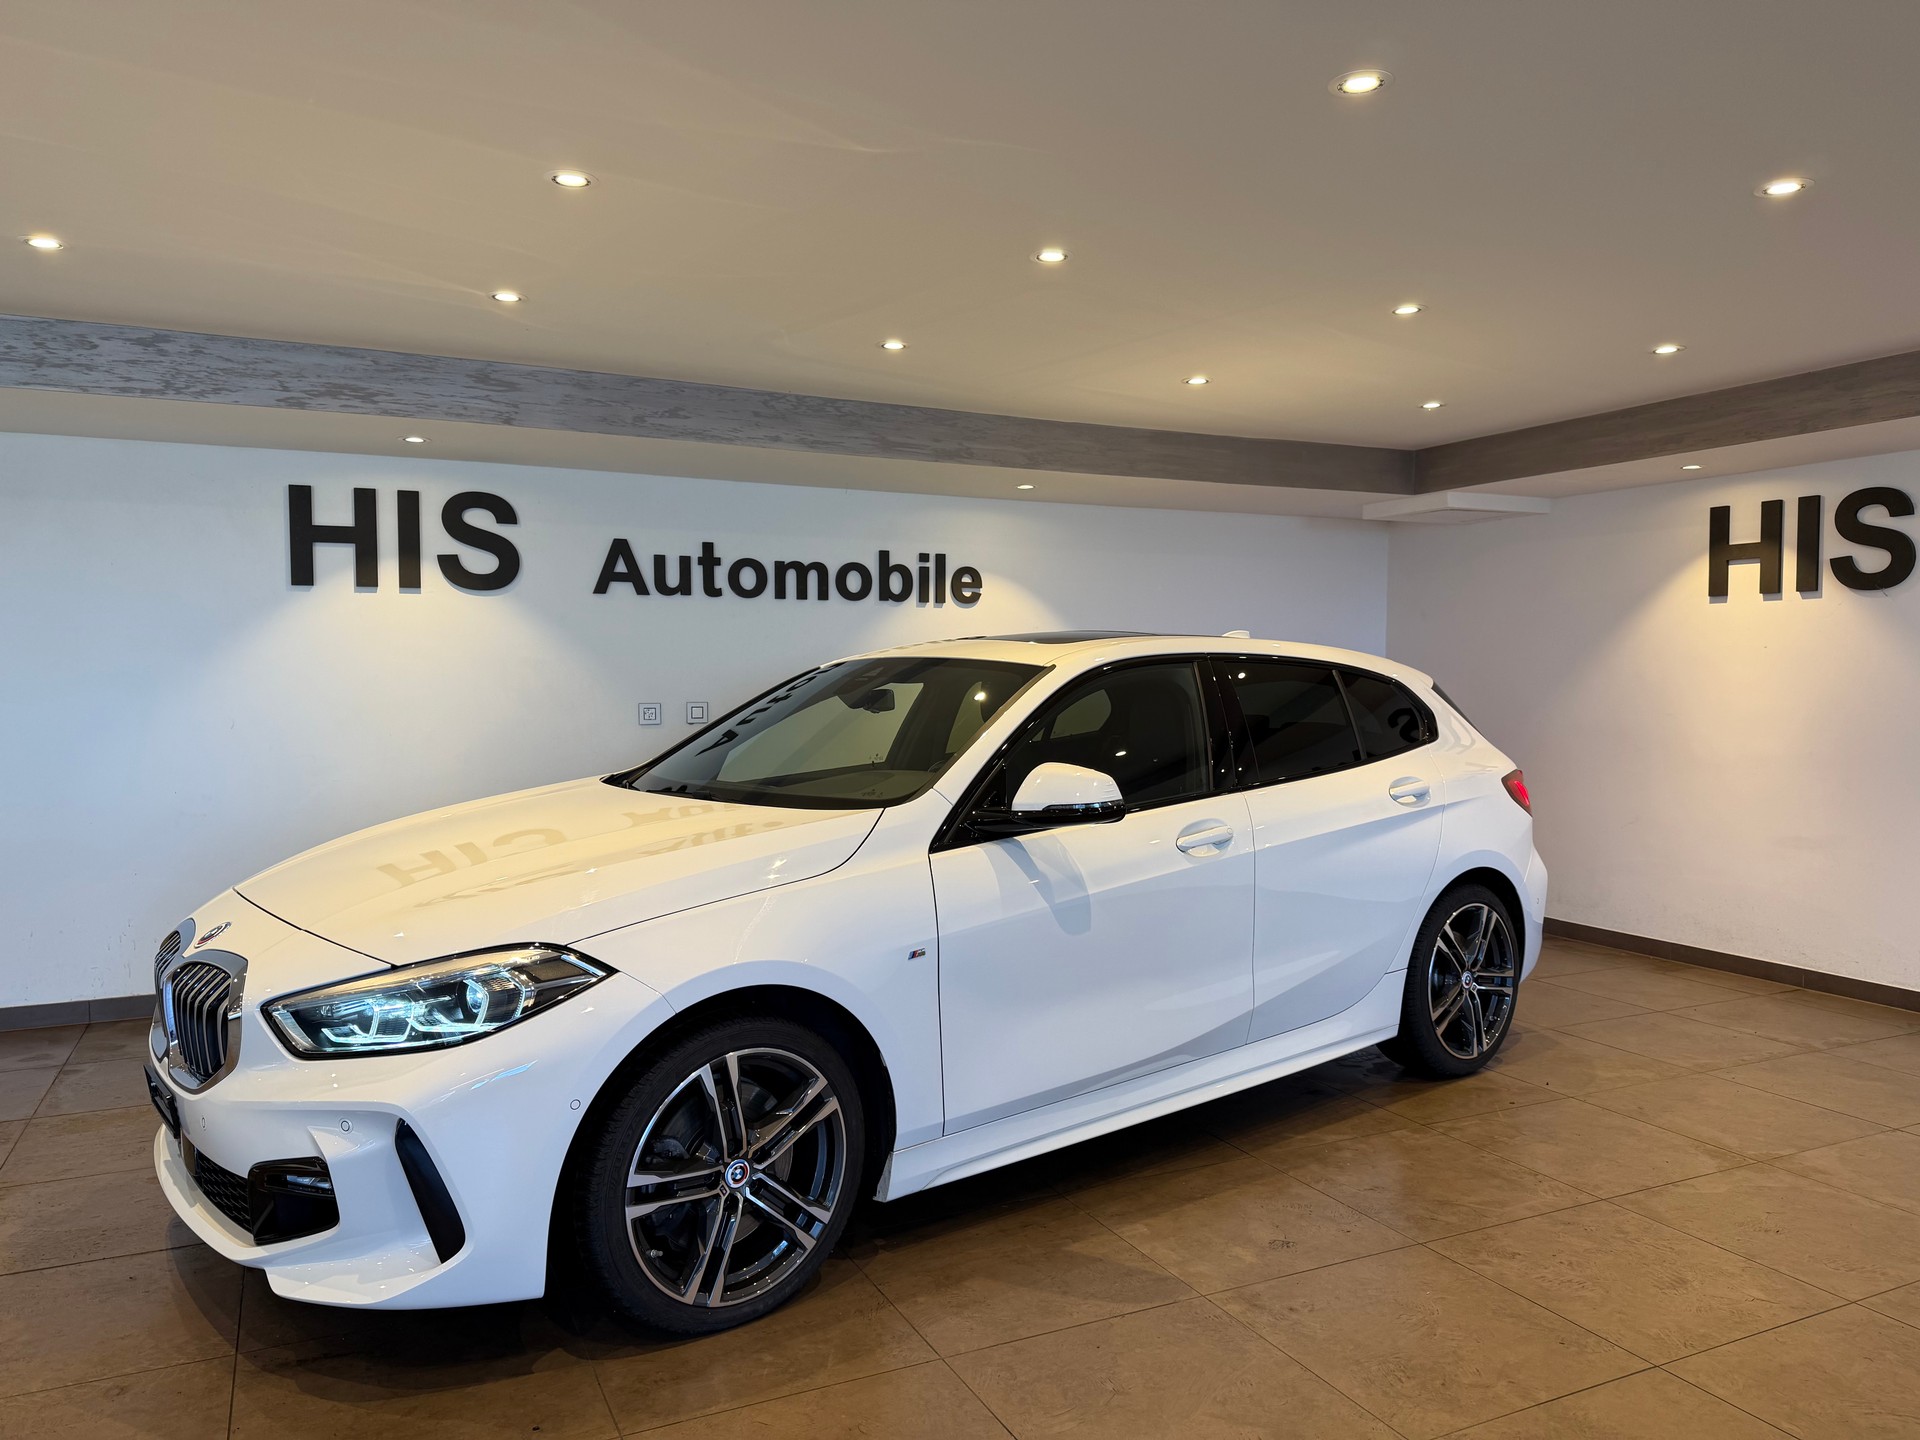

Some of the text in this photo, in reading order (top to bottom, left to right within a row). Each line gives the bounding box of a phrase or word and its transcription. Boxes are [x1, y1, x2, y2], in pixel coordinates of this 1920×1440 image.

[288, 484, 983, 604] HIS Automobile
[1708, 486, 1917, 598] HIS
